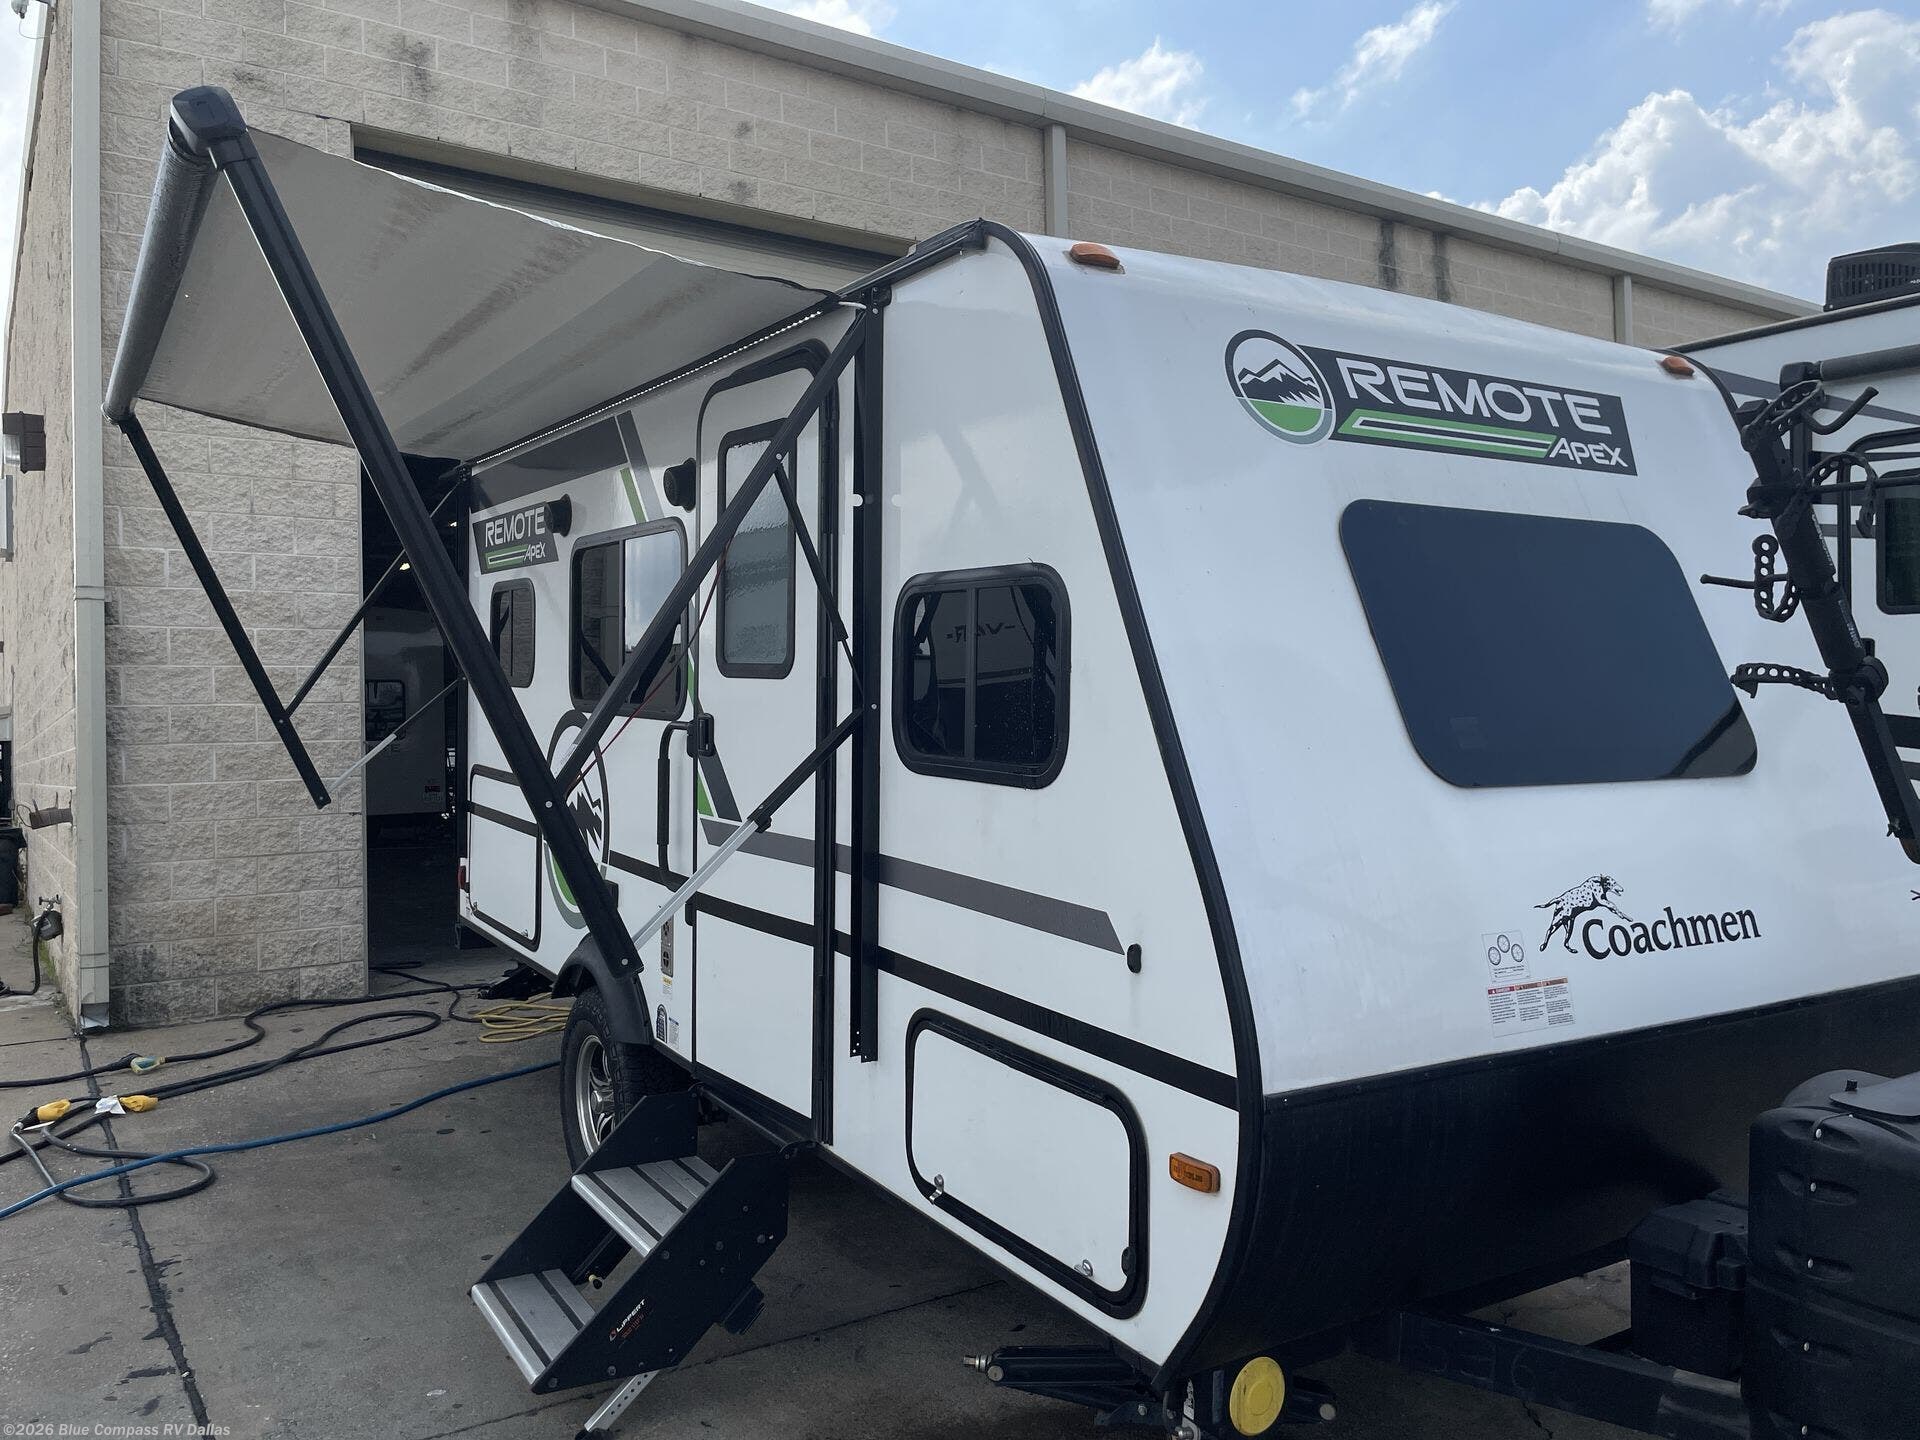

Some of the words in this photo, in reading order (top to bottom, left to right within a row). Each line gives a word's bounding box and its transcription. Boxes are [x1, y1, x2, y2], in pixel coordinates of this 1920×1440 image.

[1335, 357, 1612, 434] REMOTE
[1549, 437, 1628, 467] APEX
[485, 506, 546, 547] REMOTE
[523, 541, 546, 562] APEX
[1582, 906, 1762, 960] Coachmen
[616, 1299, 646, 1333] LIPPERT
